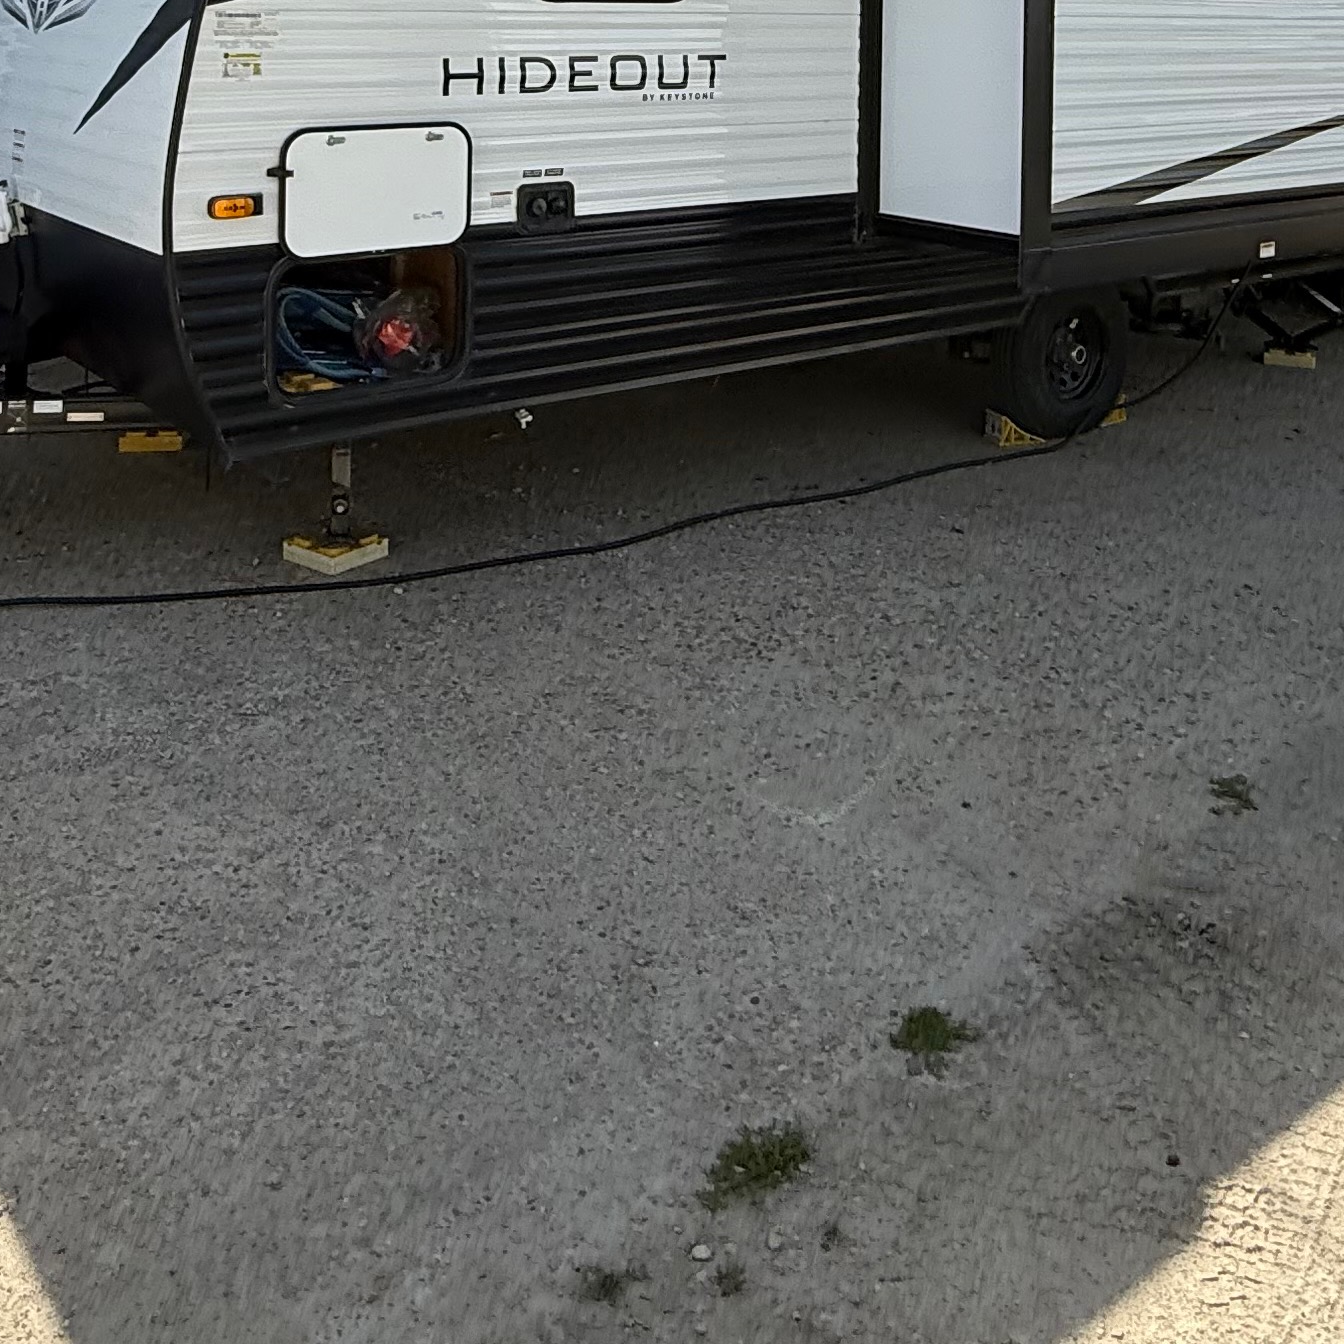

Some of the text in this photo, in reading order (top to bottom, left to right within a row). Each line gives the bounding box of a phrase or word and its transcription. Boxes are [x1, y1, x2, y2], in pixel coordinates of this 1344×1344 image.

[442, 54, 727, 96] HIDEOUT
[642, 92, 715, 102] BY KEYSTONE
